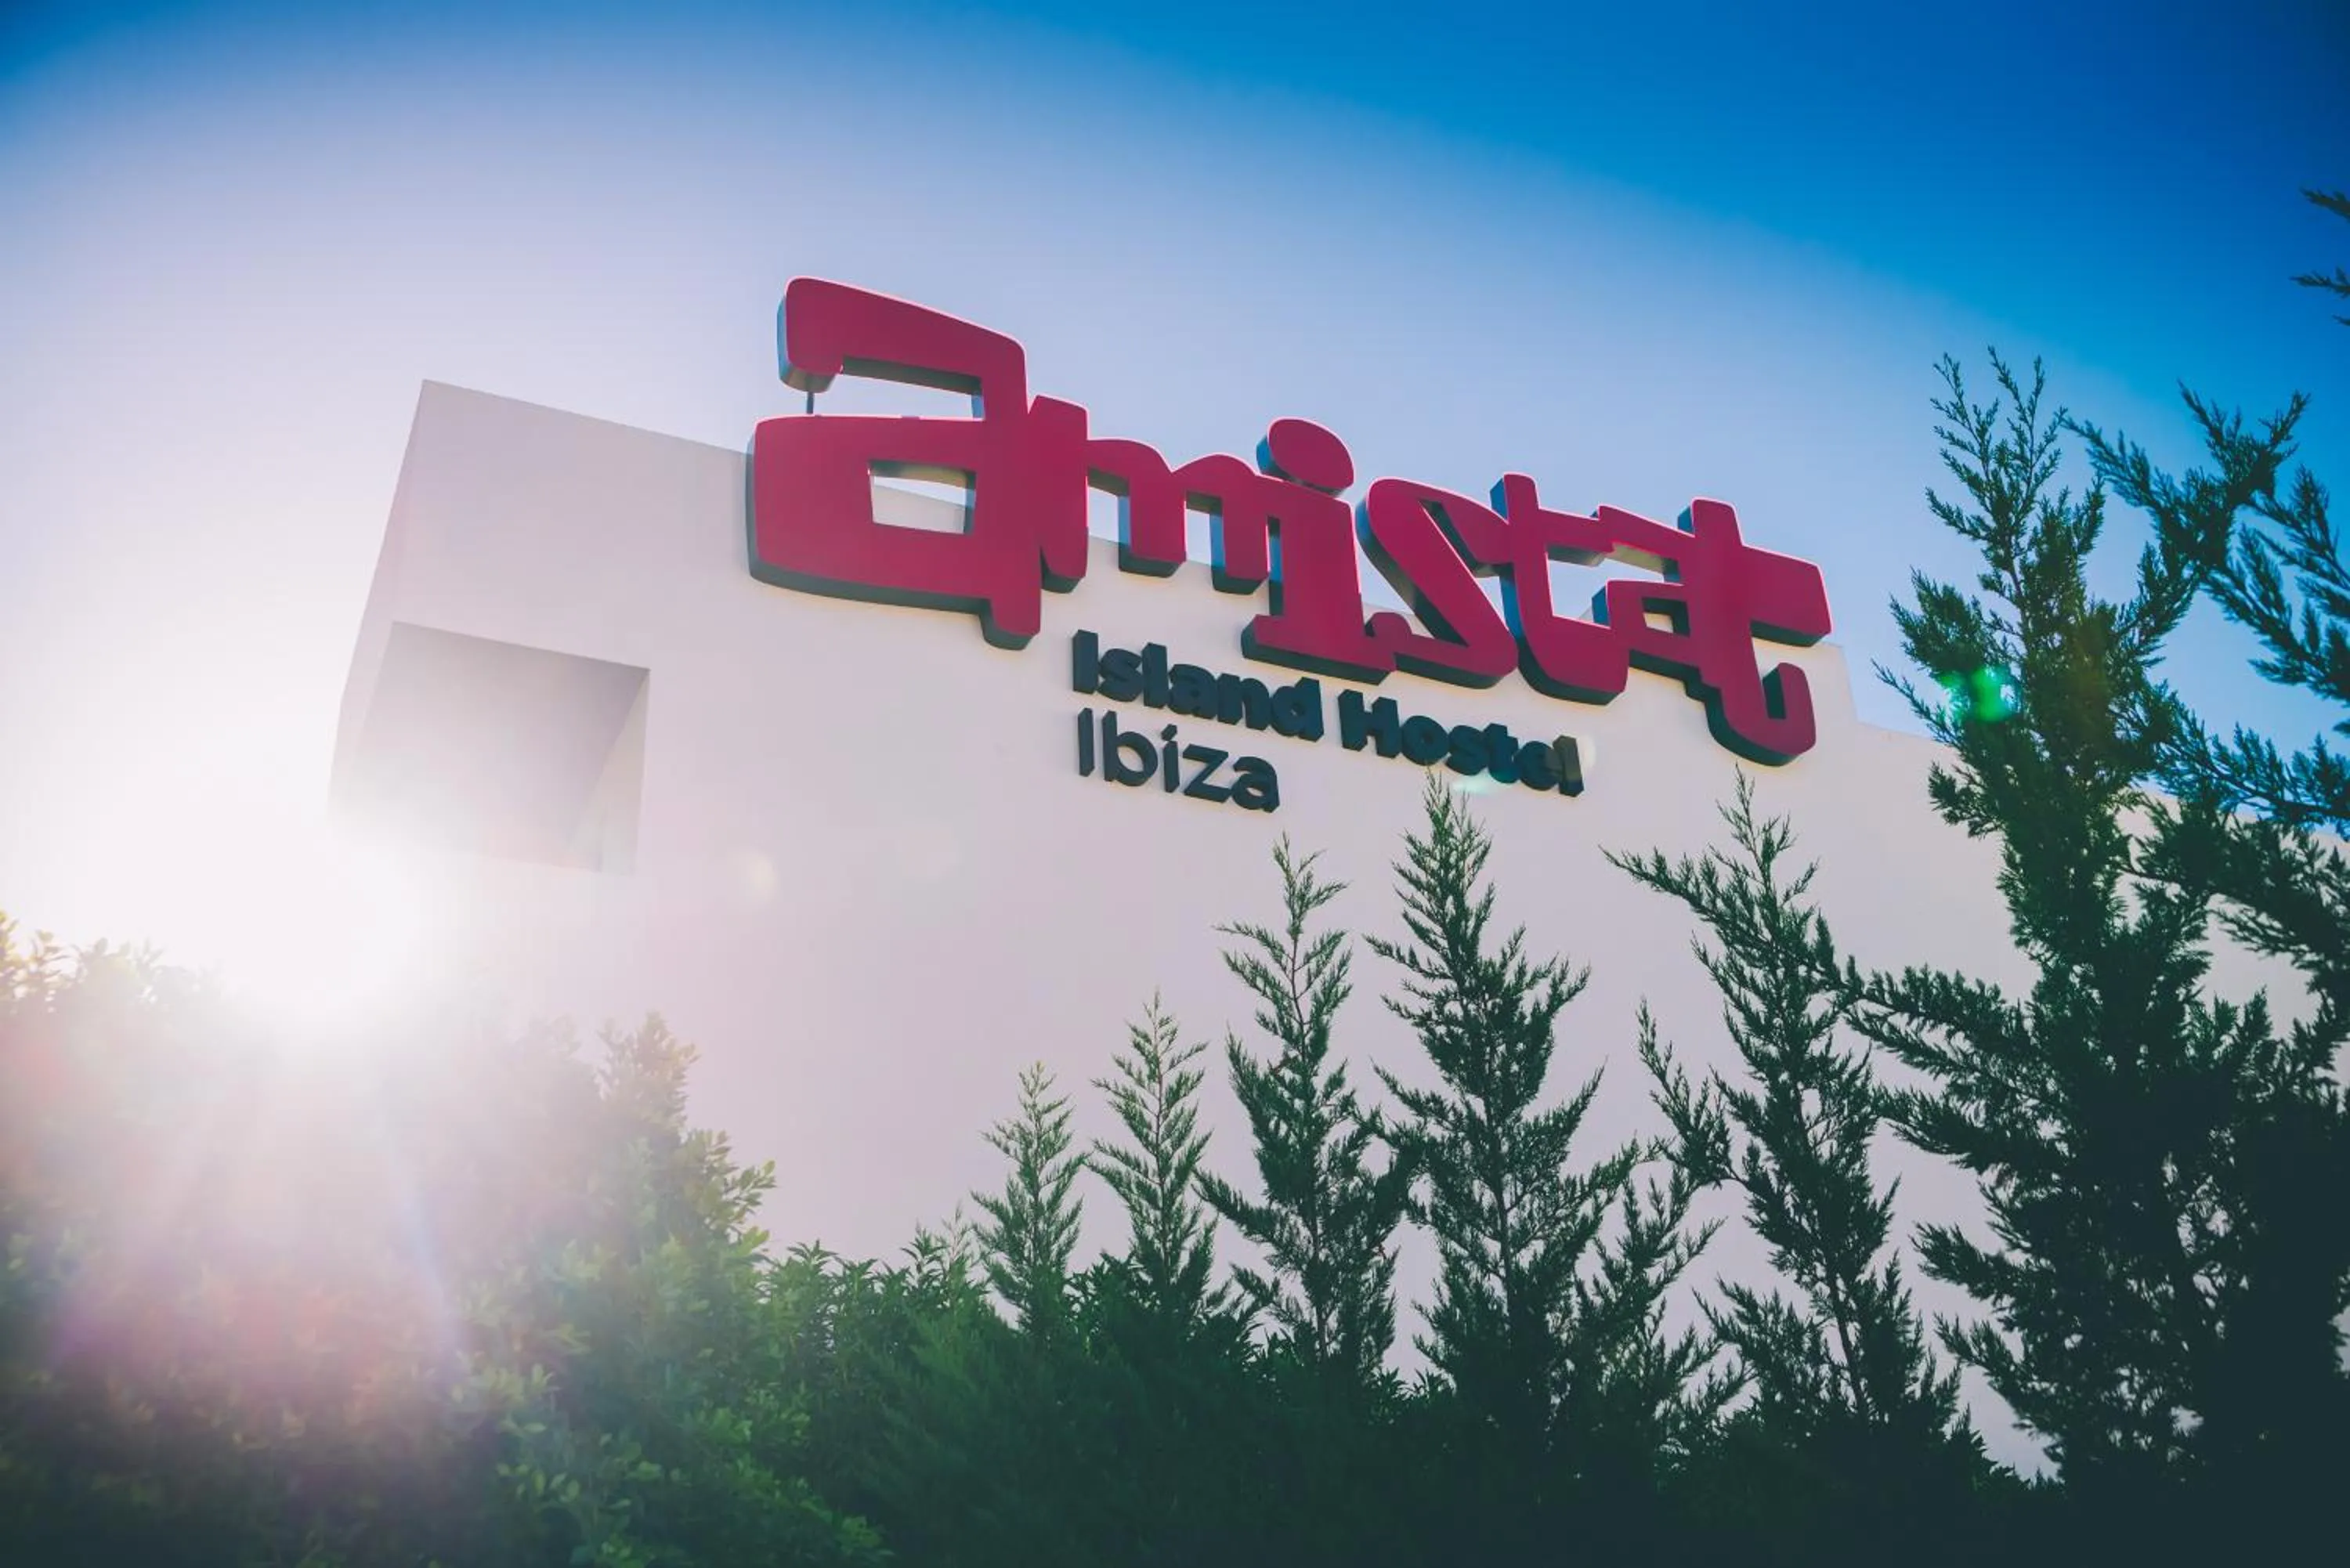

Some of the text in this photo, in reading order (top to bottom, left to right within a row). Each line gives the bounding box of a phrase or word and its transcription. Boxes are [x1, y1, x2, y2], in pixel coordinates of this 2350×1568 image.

[1072, 629, 1585, 797] Island Hostel
[1077, 707, 1280, 813] Ibiza
